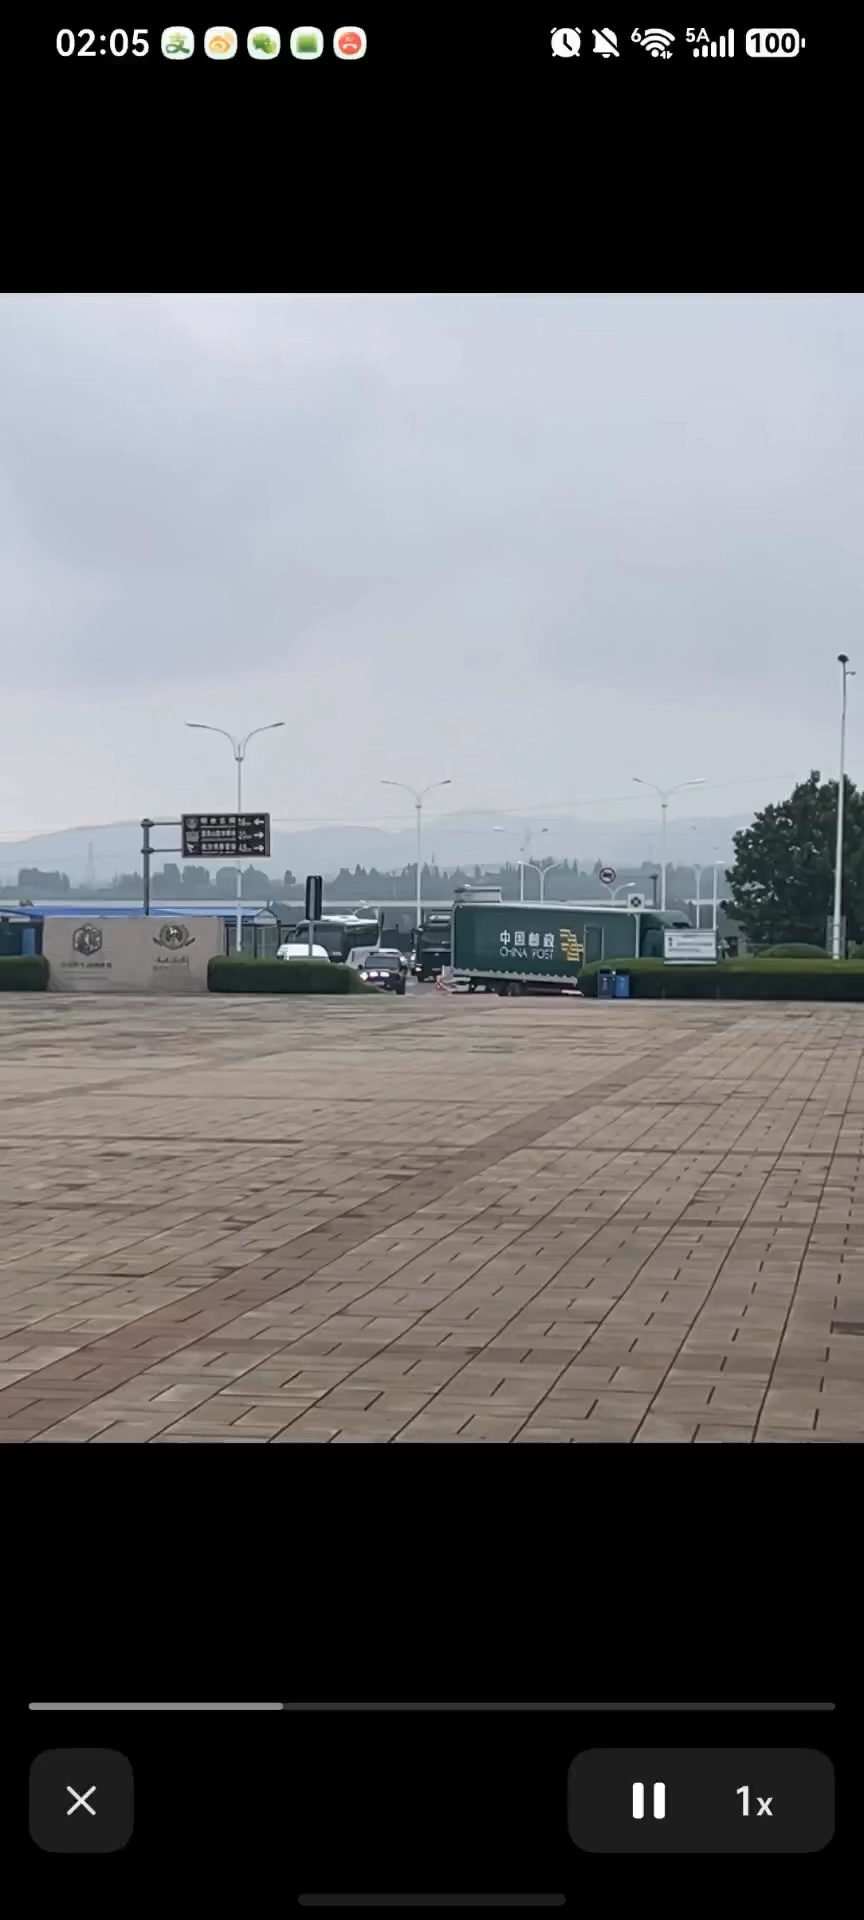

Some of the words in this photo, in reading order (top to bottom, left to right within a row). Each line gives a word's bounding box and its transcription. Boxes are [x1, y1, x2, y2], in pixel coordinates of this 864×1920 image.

[56, 28, 149, 57] 02:05
[630, 27, 642, 43] 6
[685, 27, 710, 43] 5A
[751, 32, 795, 53] 100
[736, 1785, 774, 1817] 1x
